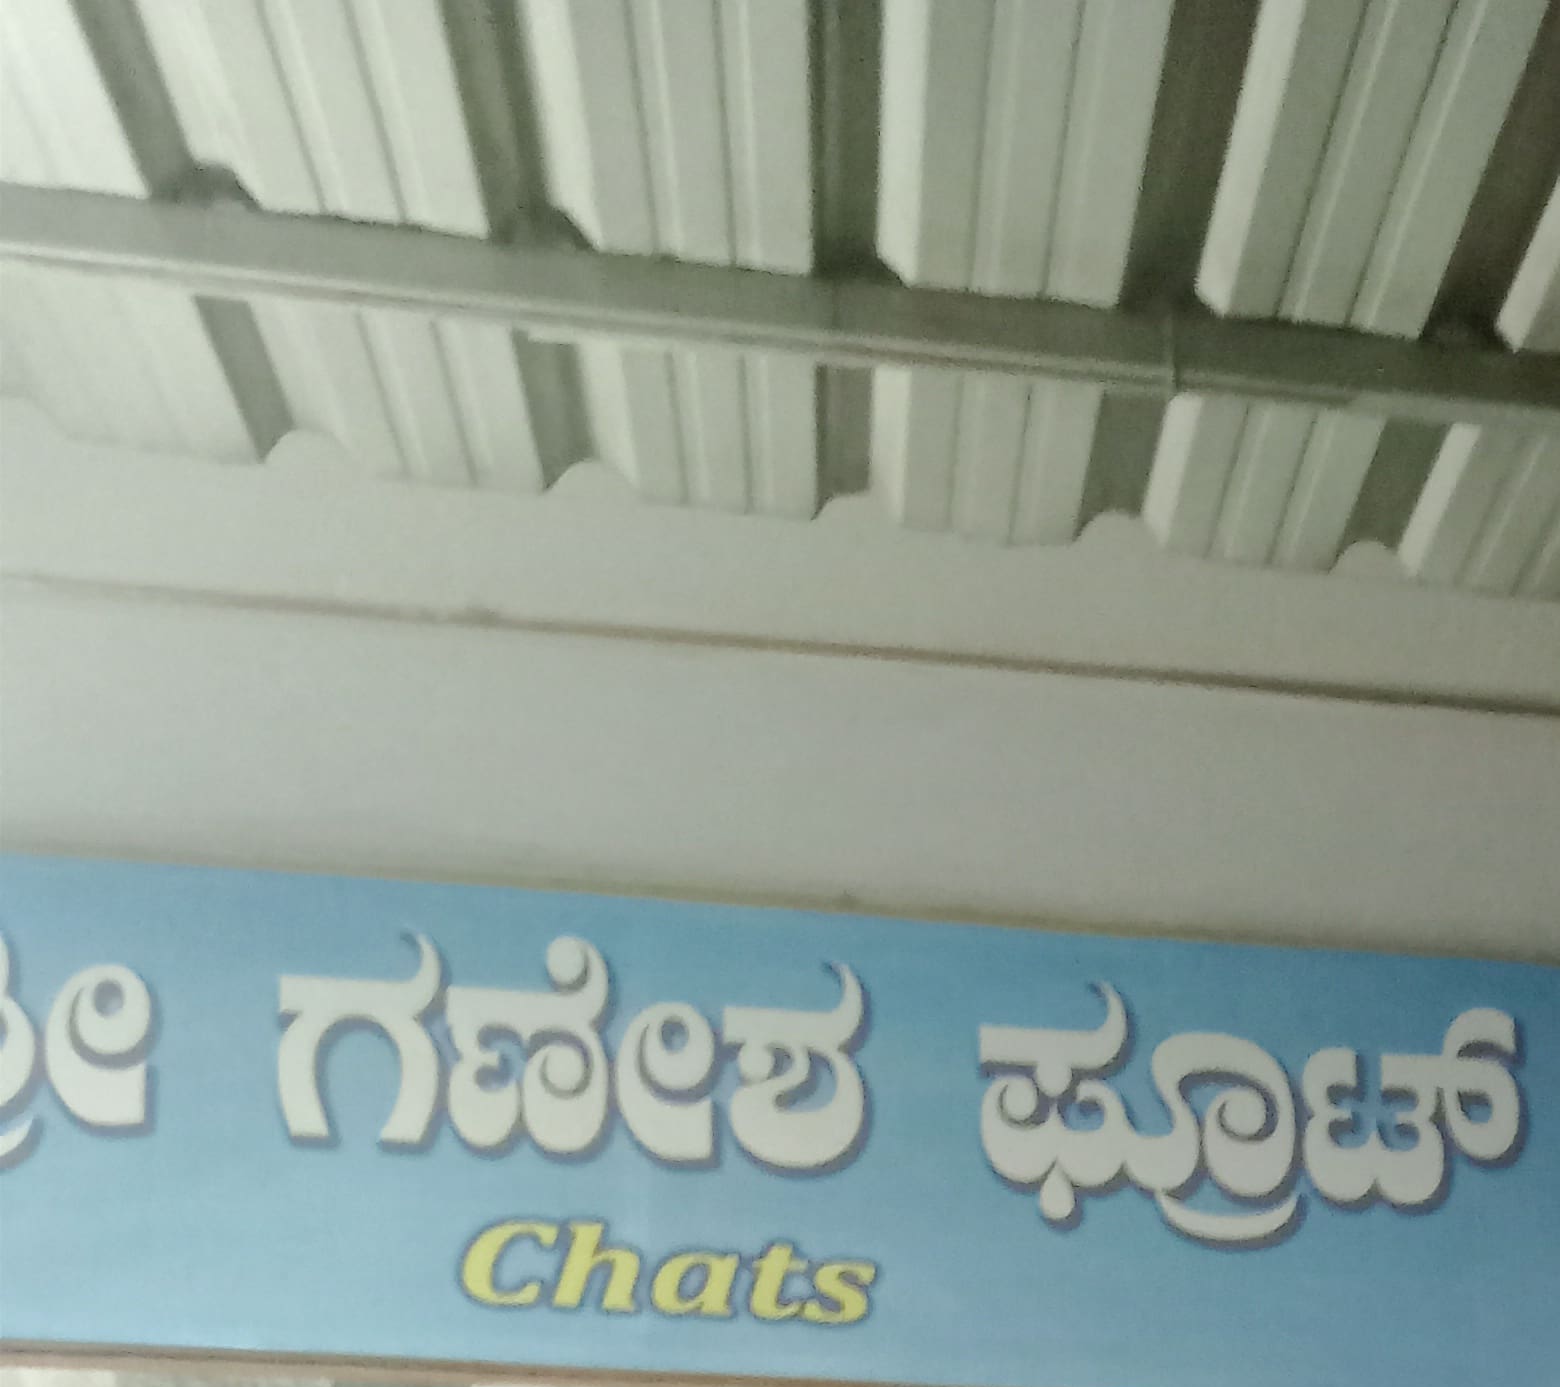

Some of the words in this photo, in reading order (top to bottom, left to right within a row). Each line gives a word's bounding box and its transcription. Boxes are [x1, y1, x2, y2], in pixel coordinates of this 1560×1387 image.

[278, 927, 866, 1171] ಗಣೇಶ
[979, 980, 1521, 1244] ಫ್ರೂಟ್
[461, 1218, 878, 1326] Chats
